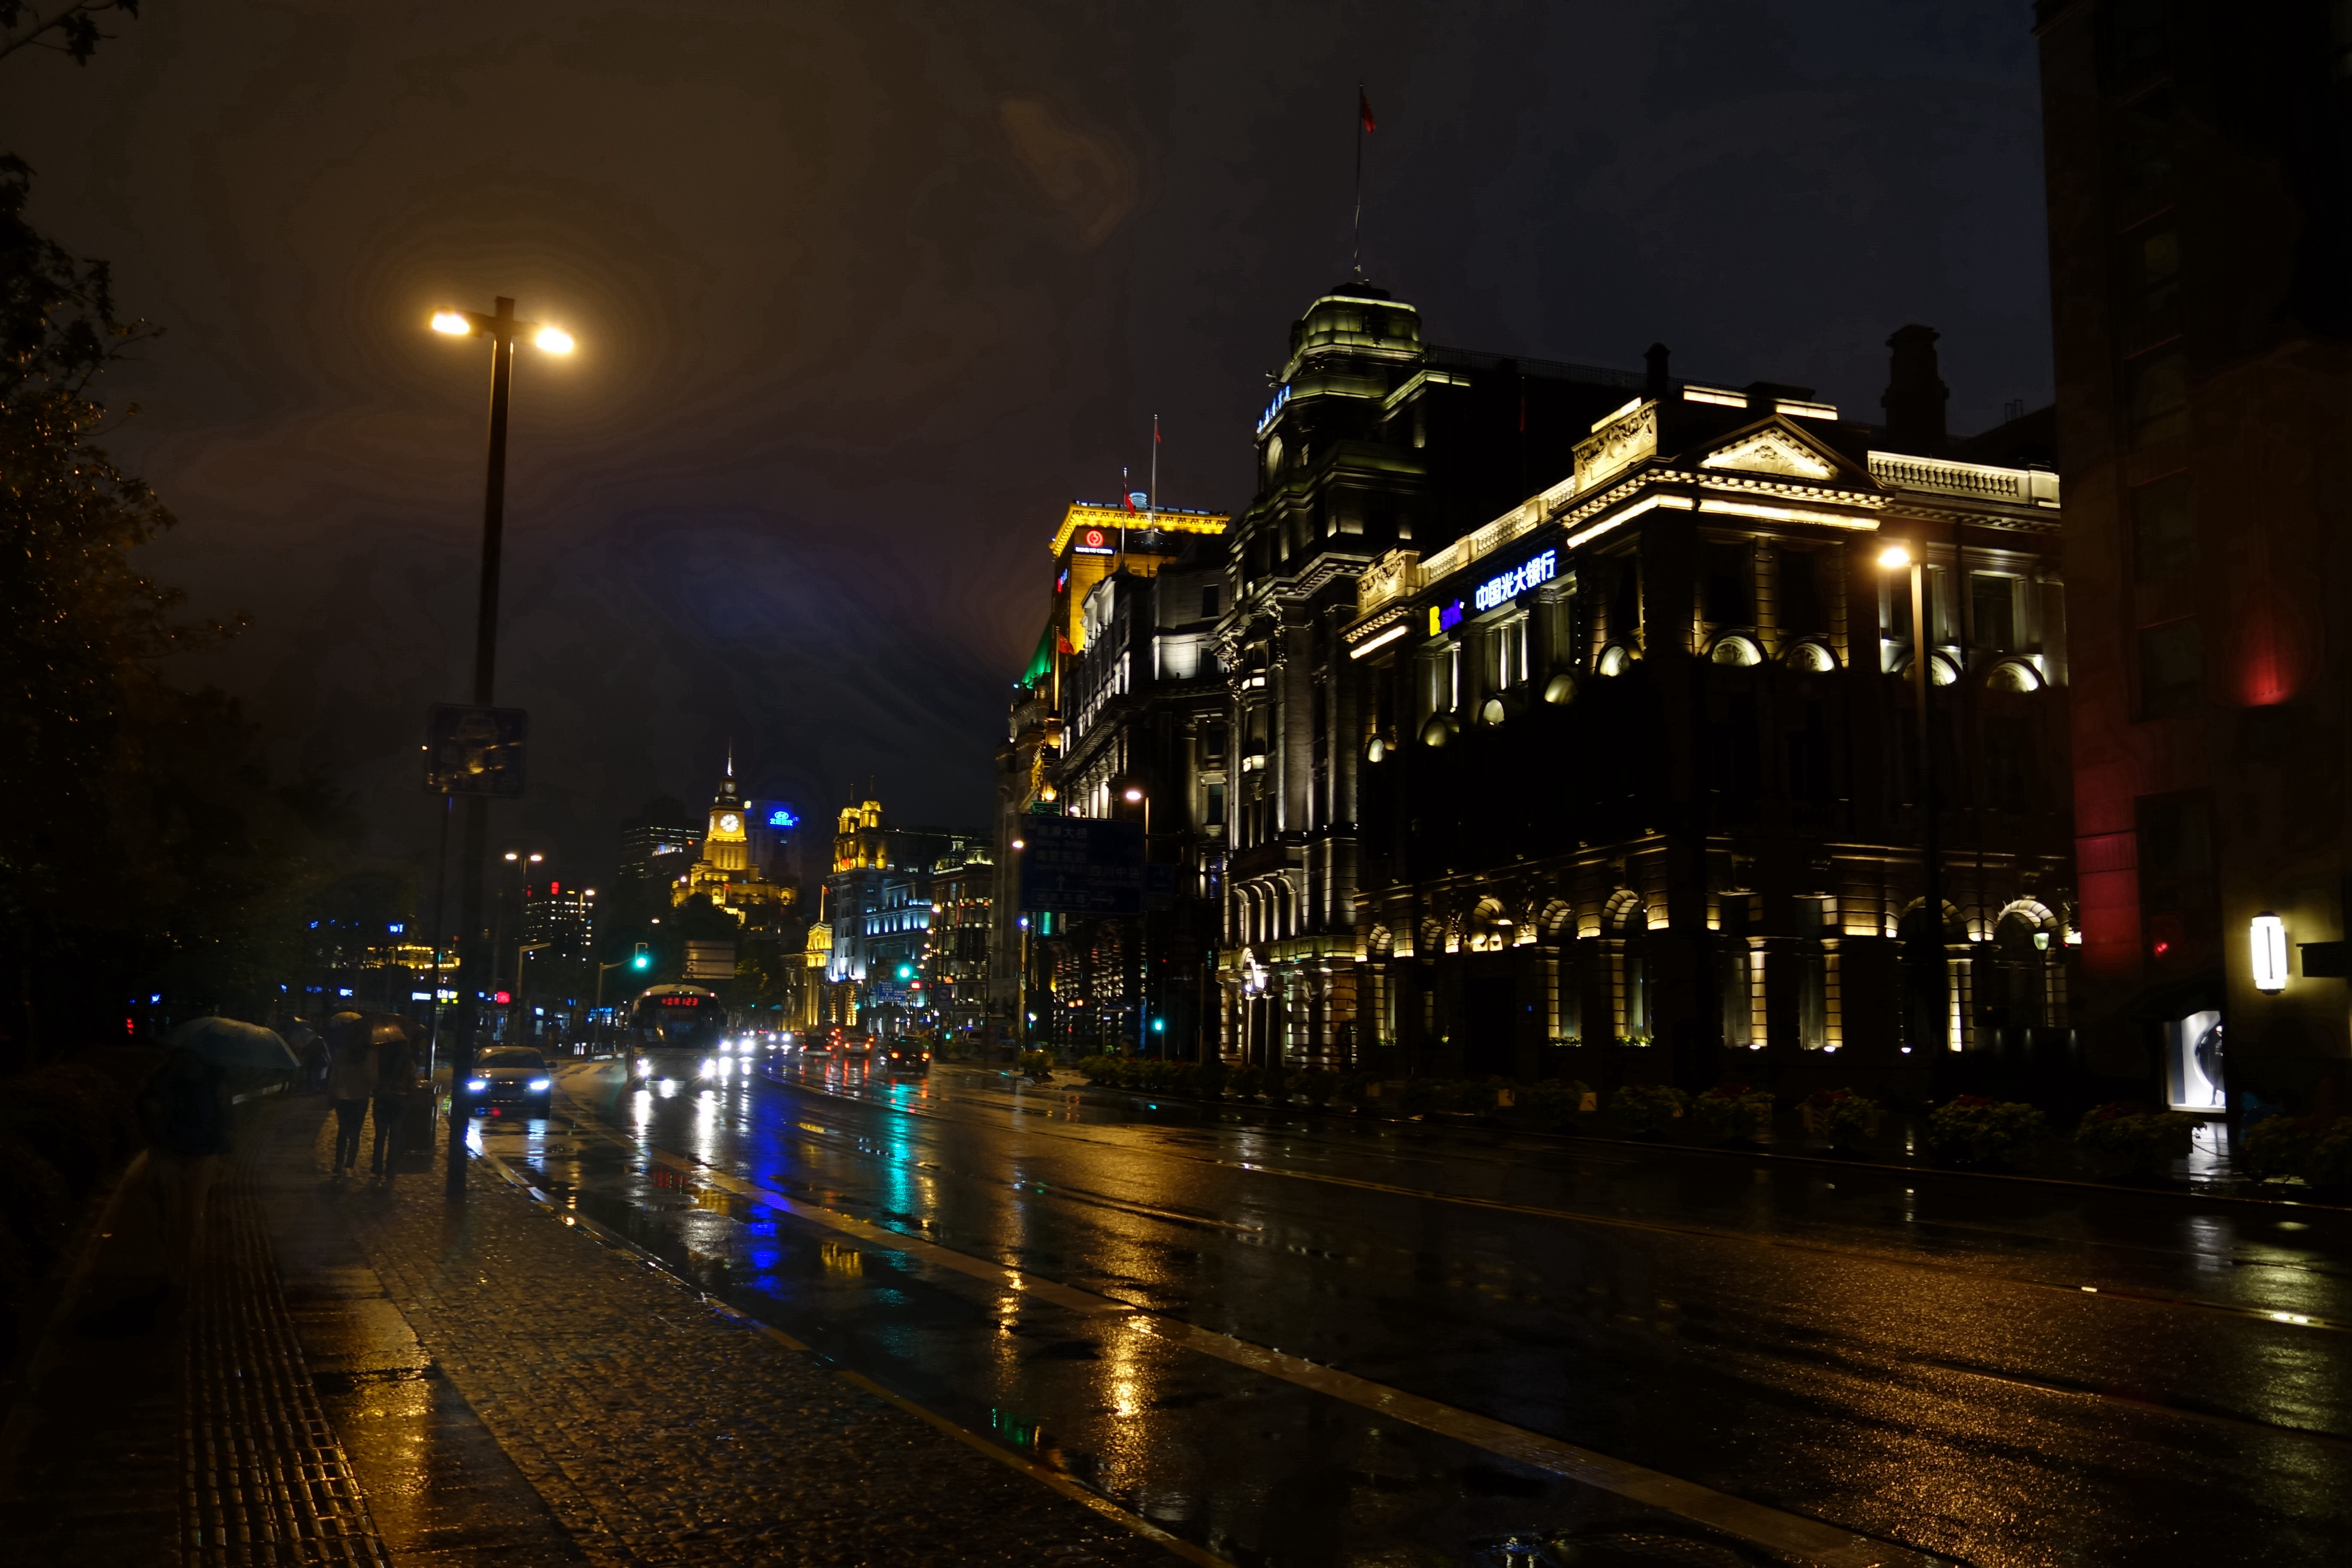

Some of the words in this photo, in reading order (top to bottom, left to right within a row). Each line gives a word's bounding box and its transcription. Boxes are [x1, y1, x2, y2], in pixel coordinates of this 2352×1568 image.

[1476, 549, 1556, 611] 中国光大银行
[1429, 599, 1463, 637] Bank
[1090, 866, 1140, 879] 四川中路
